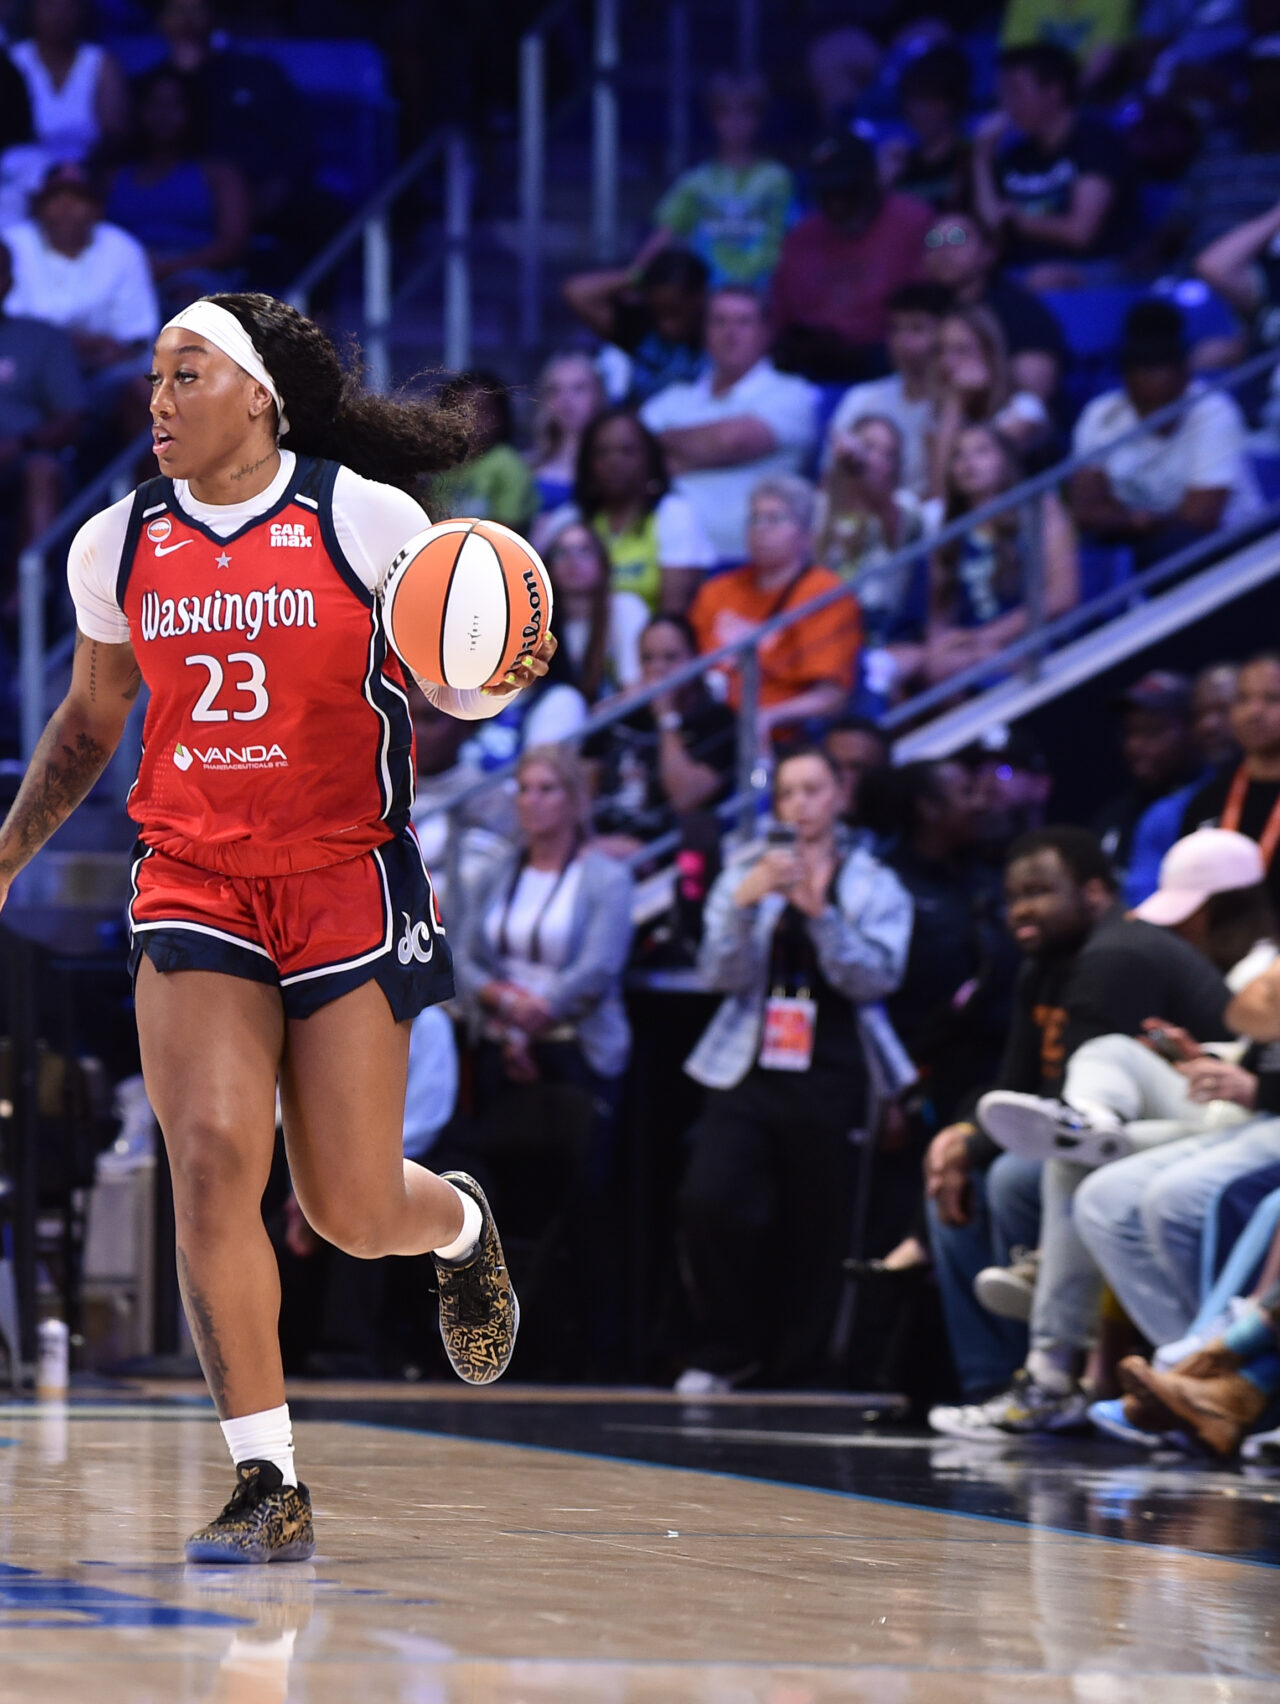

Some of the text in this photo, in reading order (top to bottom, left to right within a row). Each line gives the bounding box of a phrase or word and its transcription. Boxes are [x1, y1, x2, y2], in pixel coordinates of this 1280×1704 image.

[270, 523, 305, 536] CAR
[270, 535, 312, 548] max
[141, 583, 318, 642] Washington
[185, 652, 269, 722] 23
[193, 744, 287, 763] VANDA
[203, 762, 273, 770] PHARMACEUTICALS
